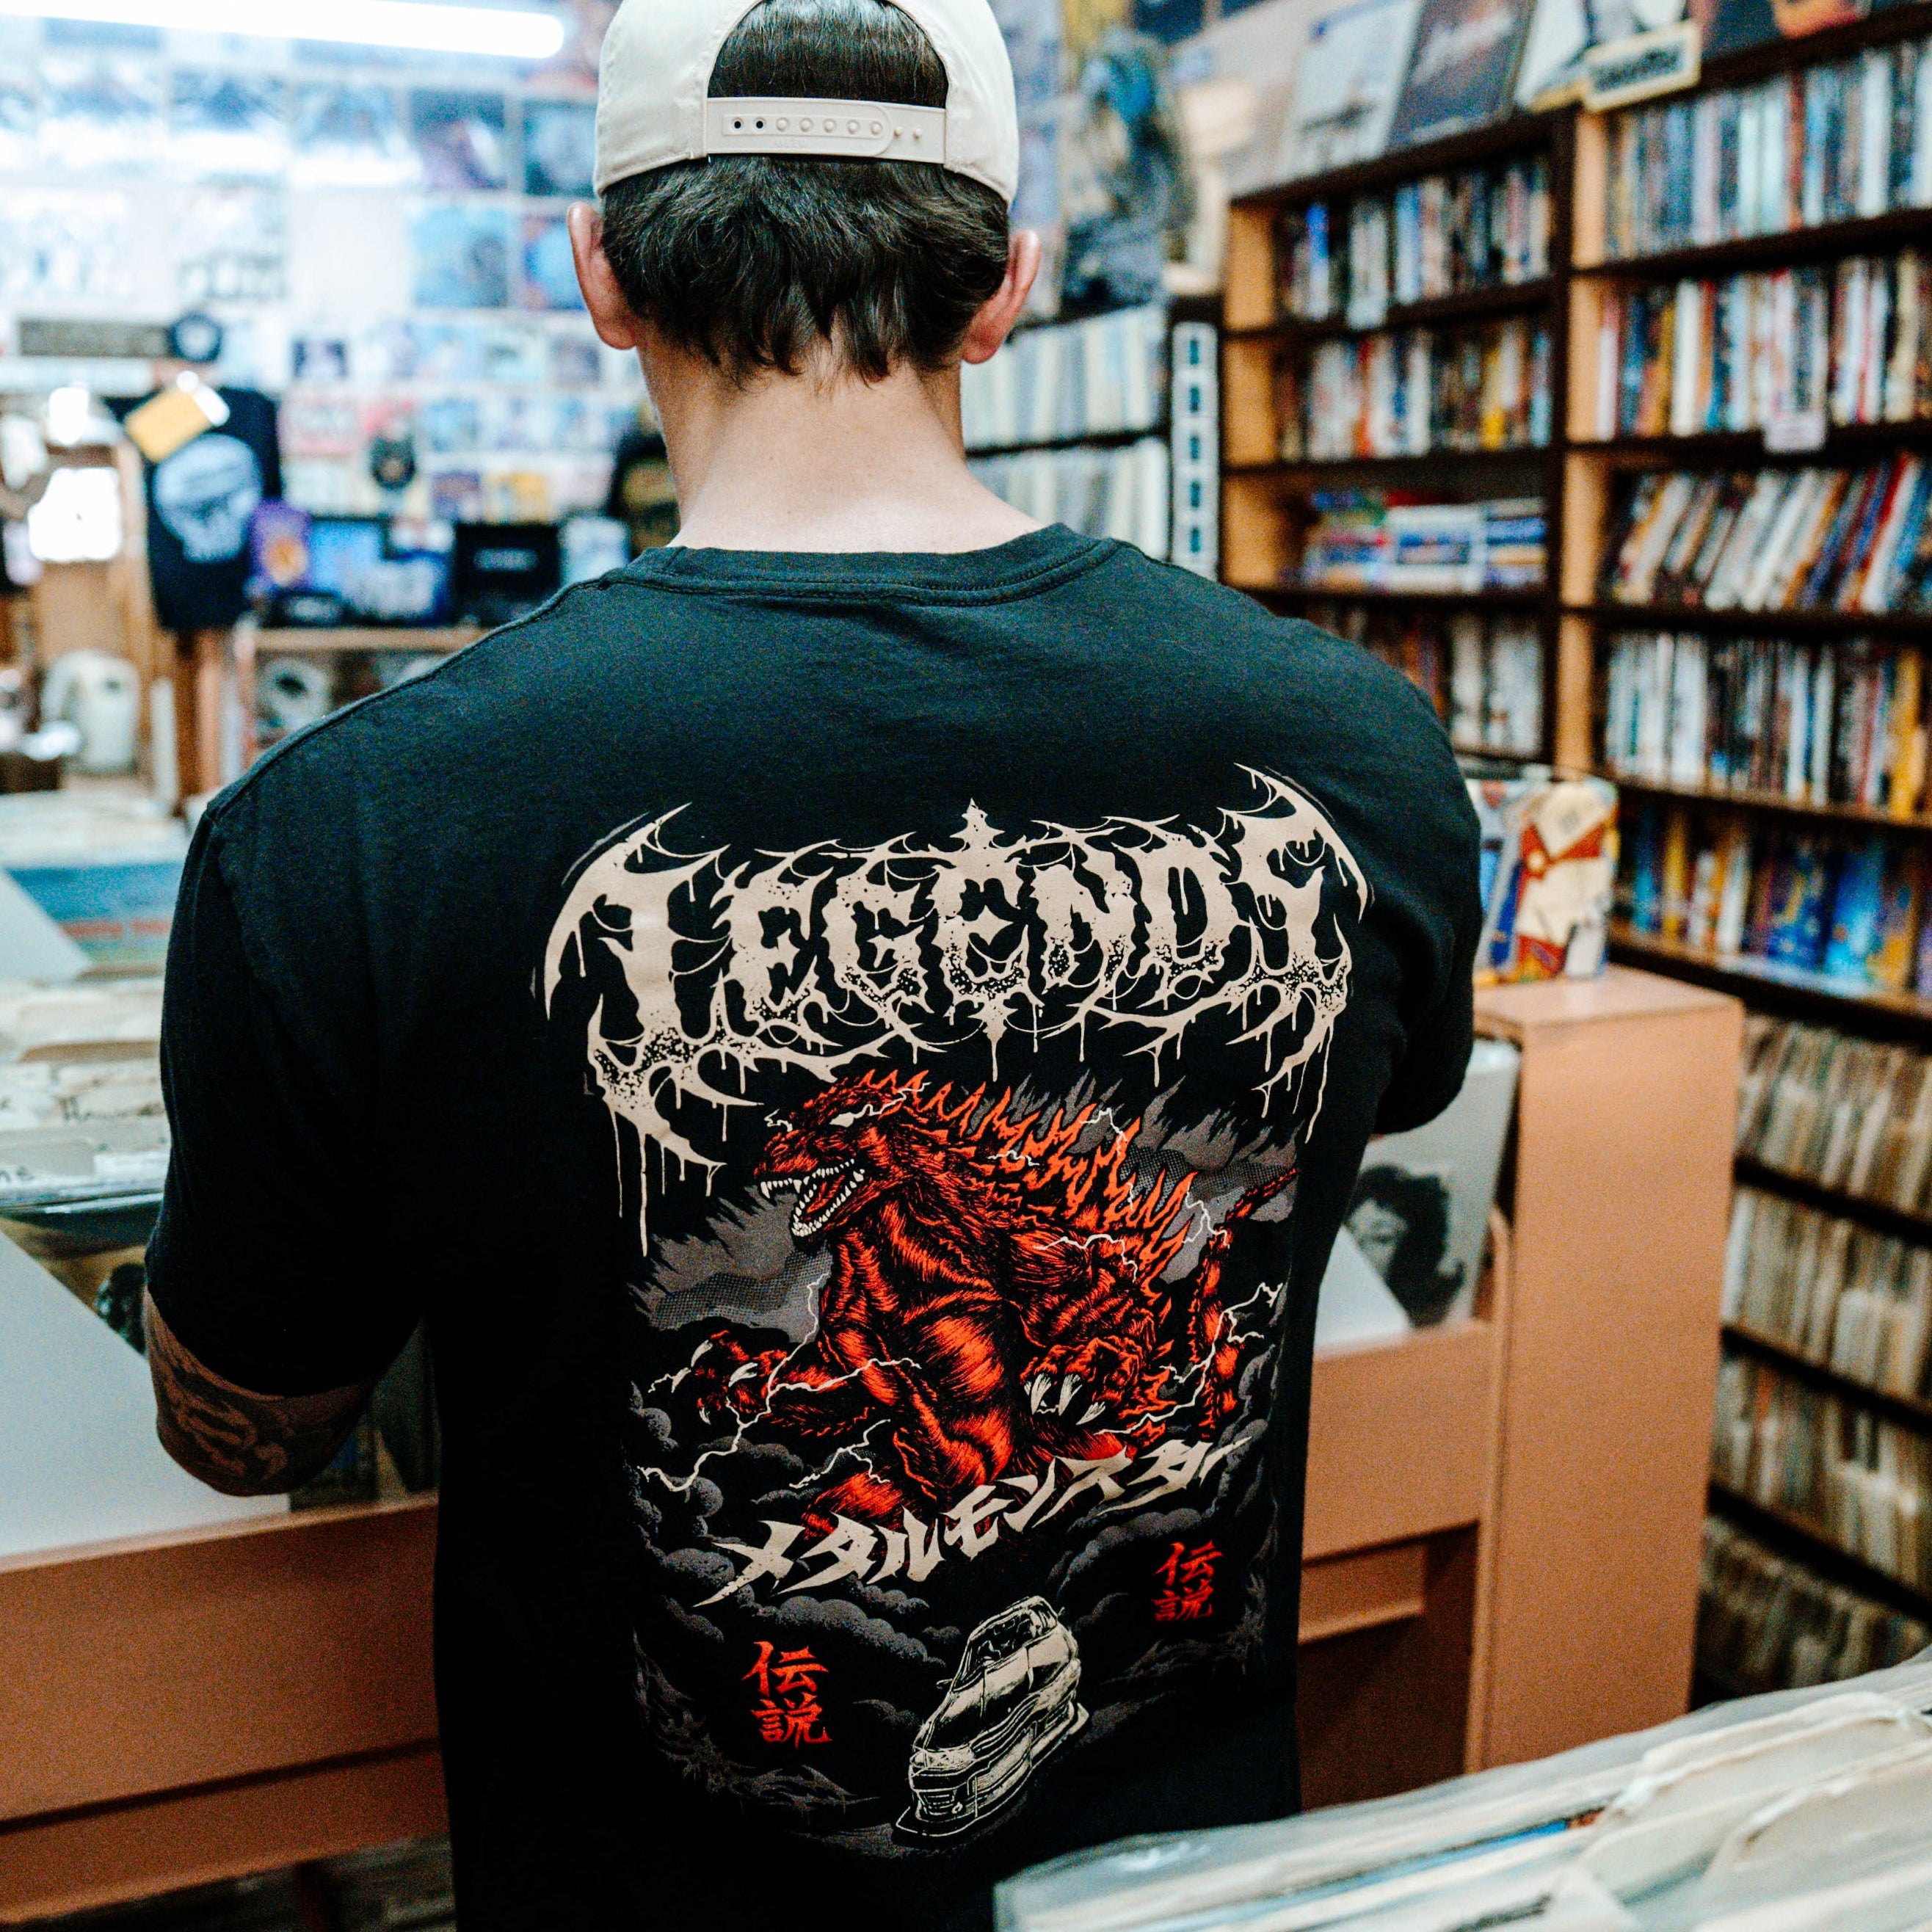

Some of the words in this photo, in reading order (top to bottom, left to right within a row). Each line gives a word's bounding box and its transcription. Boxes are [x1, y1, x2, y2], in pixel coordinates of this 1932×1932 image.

[544, 763, 1368, 1182] LEGENDS
[693, 1435, 1252, 1608] メタルモンスター
[1151, 1539, 1224, 1622] 伝説
[741, 1641, 833, 1750] 伝説
